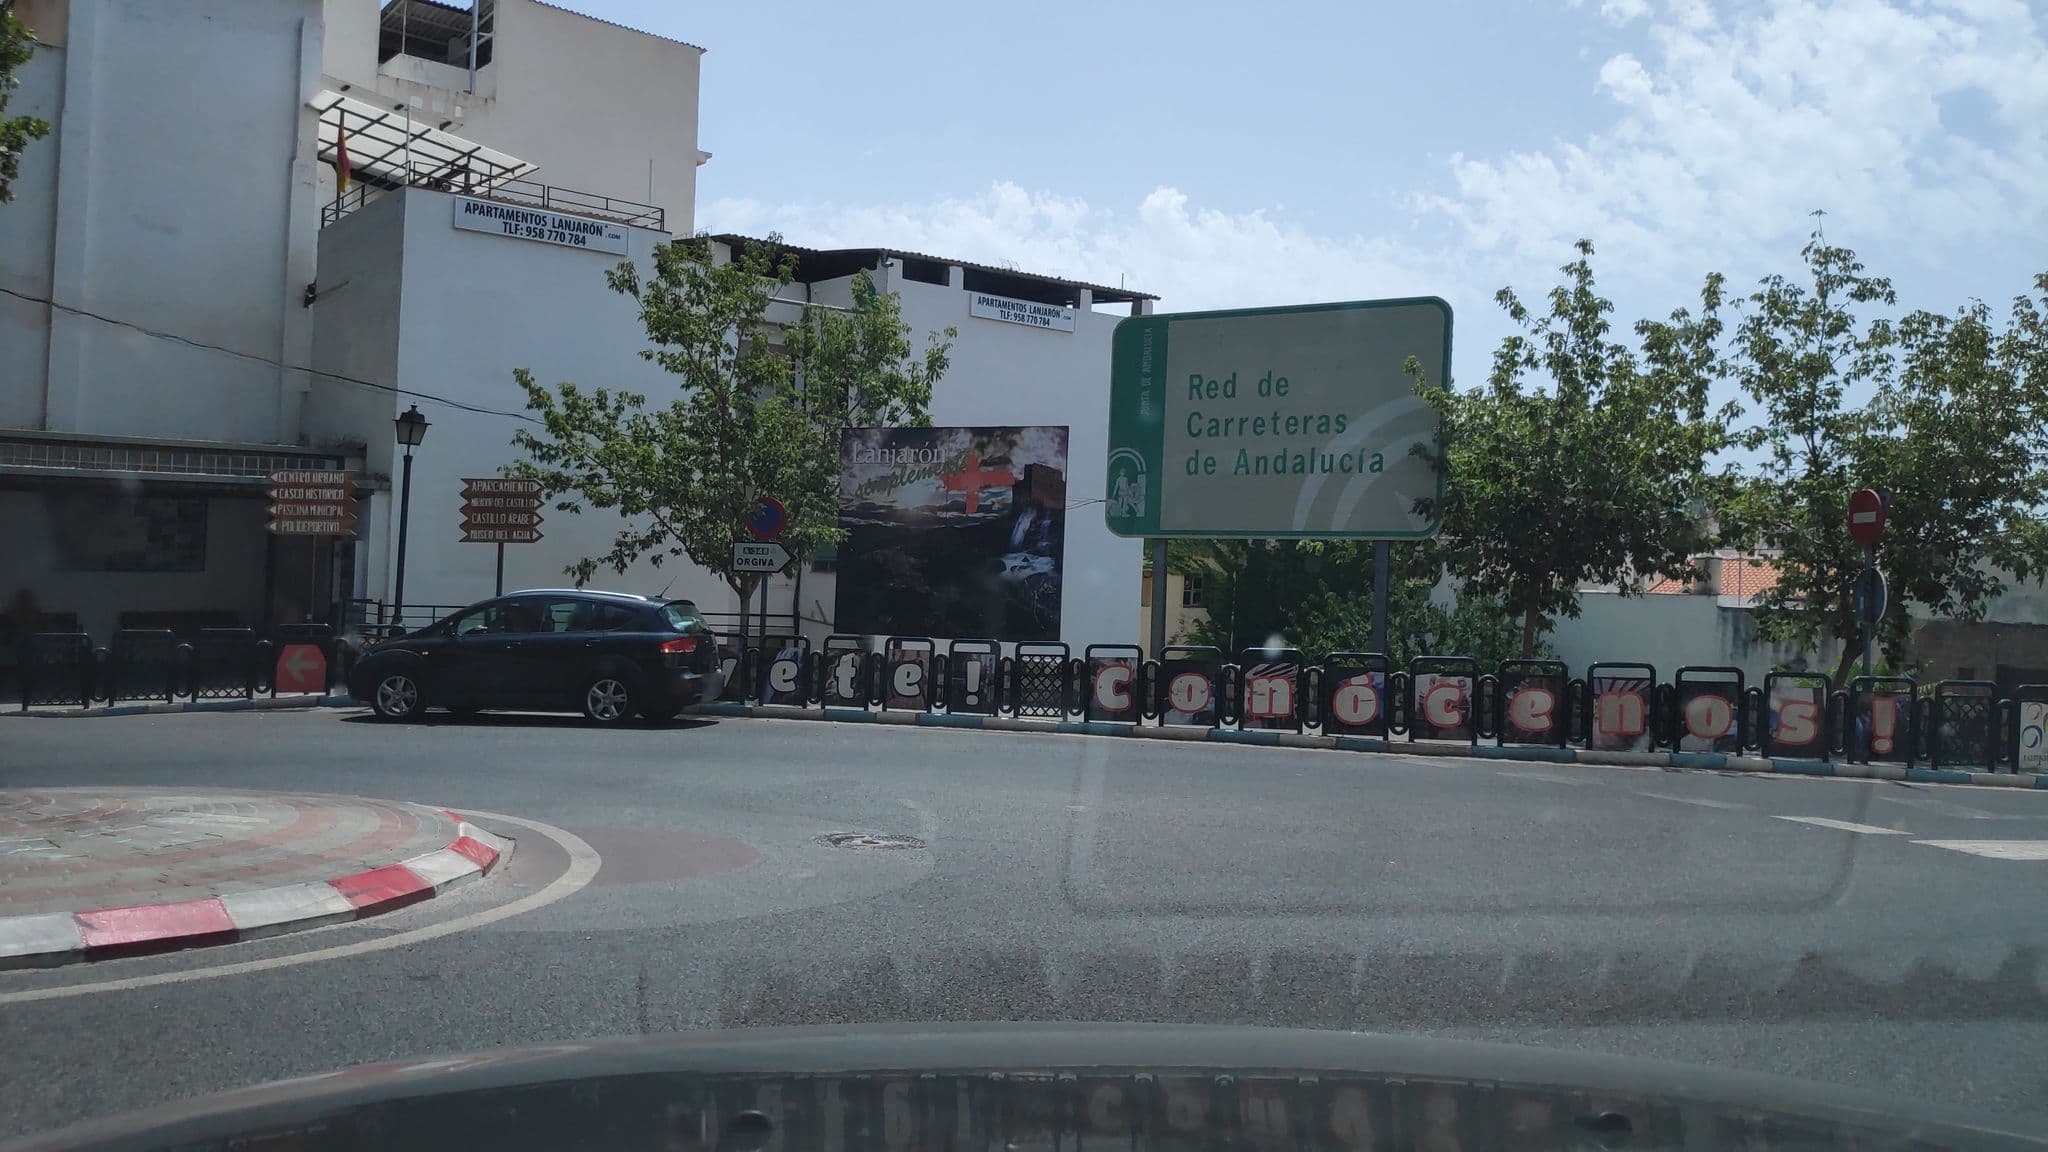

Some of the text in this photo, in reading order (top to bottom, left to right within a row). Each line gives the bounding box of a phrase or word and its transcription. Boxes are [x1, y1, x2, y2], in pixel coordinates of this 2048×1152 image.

[465, 202, 547, 227] APARTAMENTOS
[552, 218, 603, 236] LANJARÓN
[502, 222, 586, 246] TLF: 958 770 784
[978, 296, 1060, 318] APARTAMENTOS LANJARÓN
[1000, 310, 1050, 326] TLF: 958 770 784
[1188, 370, 1288, 400] Red de
[1186, 412, 1347, 438] Carreteras
[852, 442, 947, 469] Lanjarón
[1186, 448, 1384, 476] de Andalucía
[279, 472, 344, 484] CENTRO URBANO
[472, 481, 535, 492] APARCAMIENTO
[280, 489, 303, 499] CASCO
[507, 498, 534, 507] CASTILLO
[278, 505, 343, 516] PISCINA MUNICIPAL
[472, 513, 505, 523] CASTILLO
[282, 521, 339, 532] POLIDEPORTIVO
[471, 530, 493, 539] MUSEO
[496, 530, 507, 539] DEL
[737, 558, 774, 567] ORGIVA
